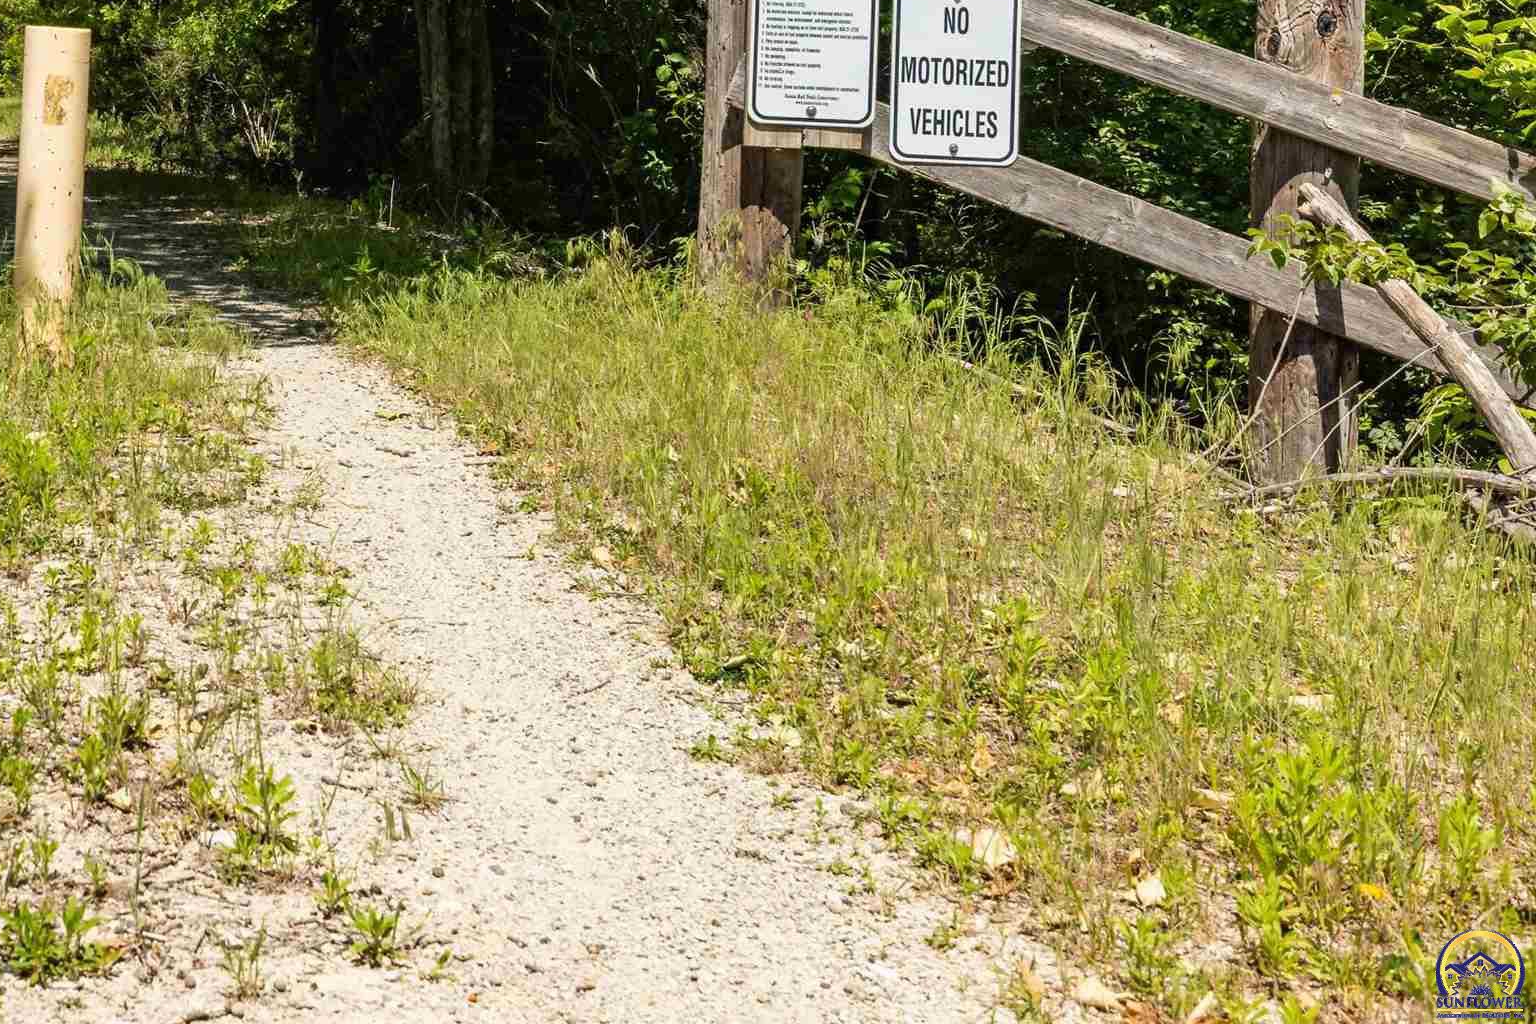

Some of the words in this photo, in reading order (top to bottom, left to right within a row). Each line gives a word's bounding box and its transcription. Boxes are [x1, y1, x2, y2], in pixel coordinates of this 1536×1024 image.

[944, 7, 969, 35] NO
[901, 57, 1009, 87] MOTORIZED
[910, 108, 997, 138] VEHICLES
